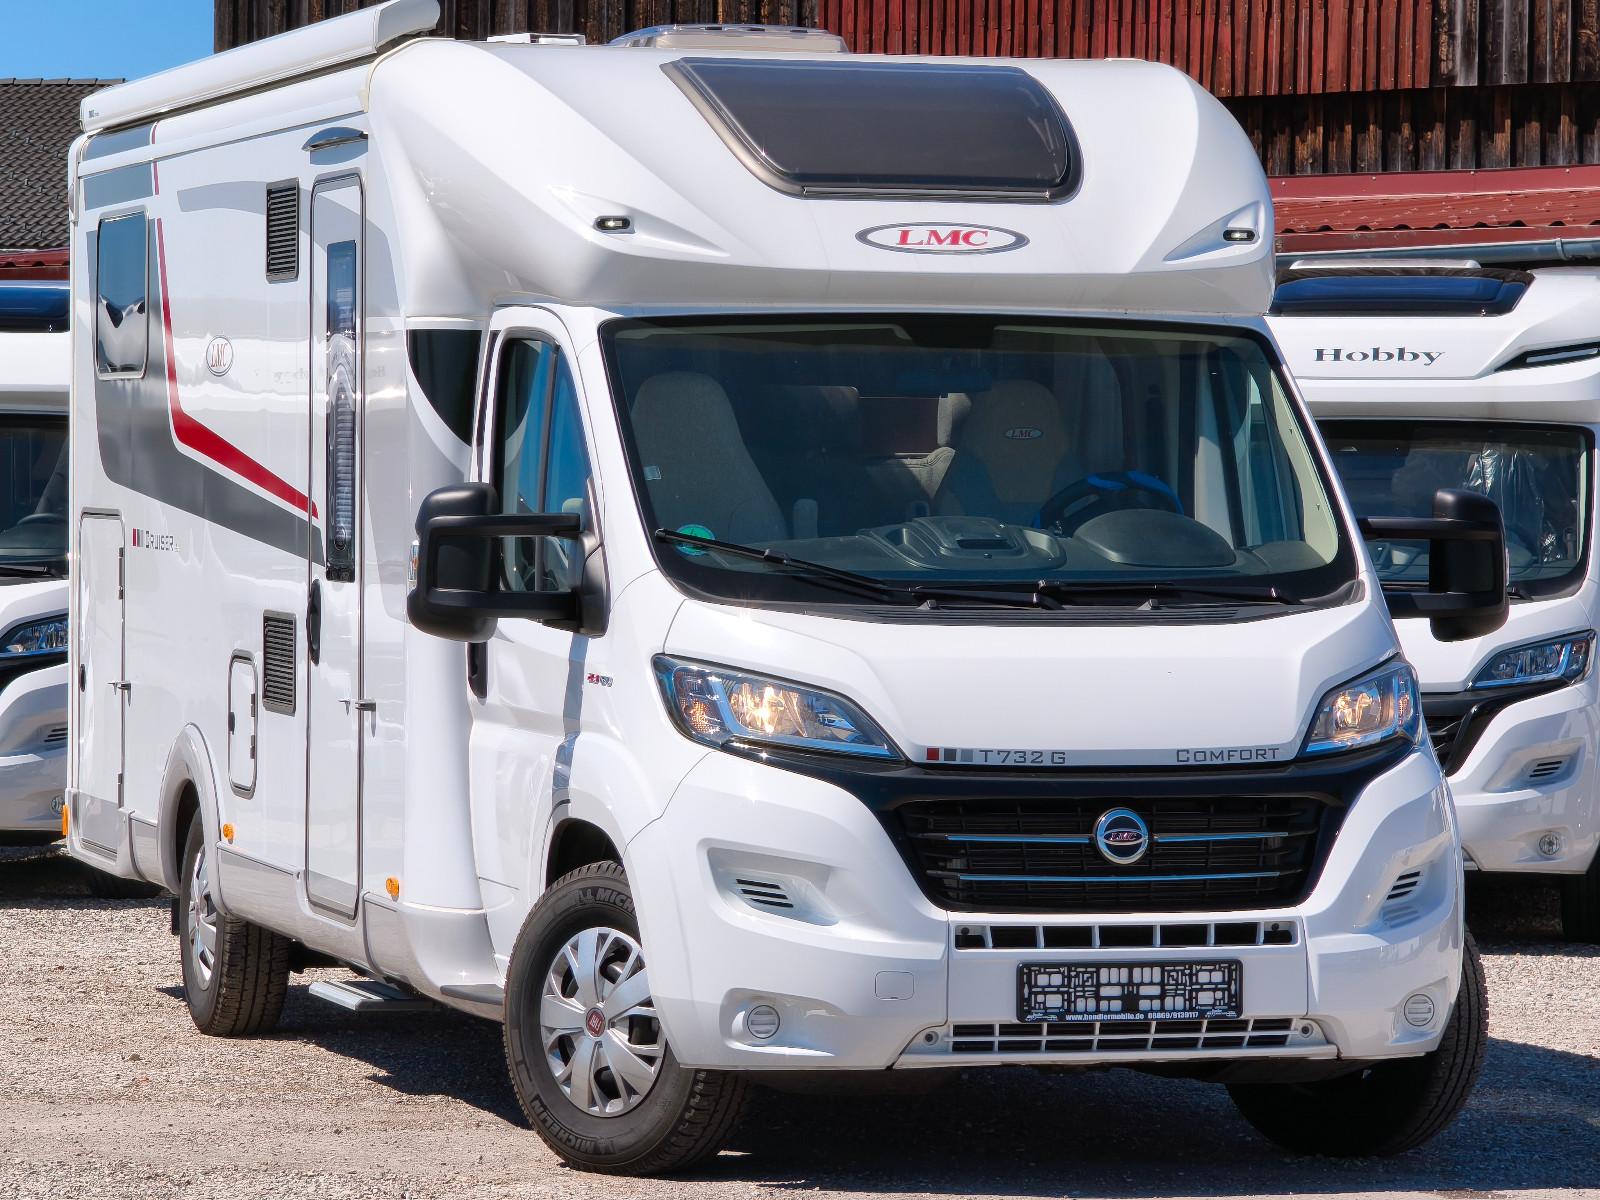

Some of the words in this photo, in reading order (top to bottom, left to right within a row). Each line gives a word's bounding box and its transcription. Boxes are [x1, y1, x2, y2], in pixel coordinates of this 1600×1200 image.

[896, 229, 989, 247] LMC
[210, 342, 228, 368] LMC
[1313, 346, 1445, 366] Hobby
[1176, 747, 1280, 763] COMFORT
[530, 1098, 596, 1154] MICHELIN
